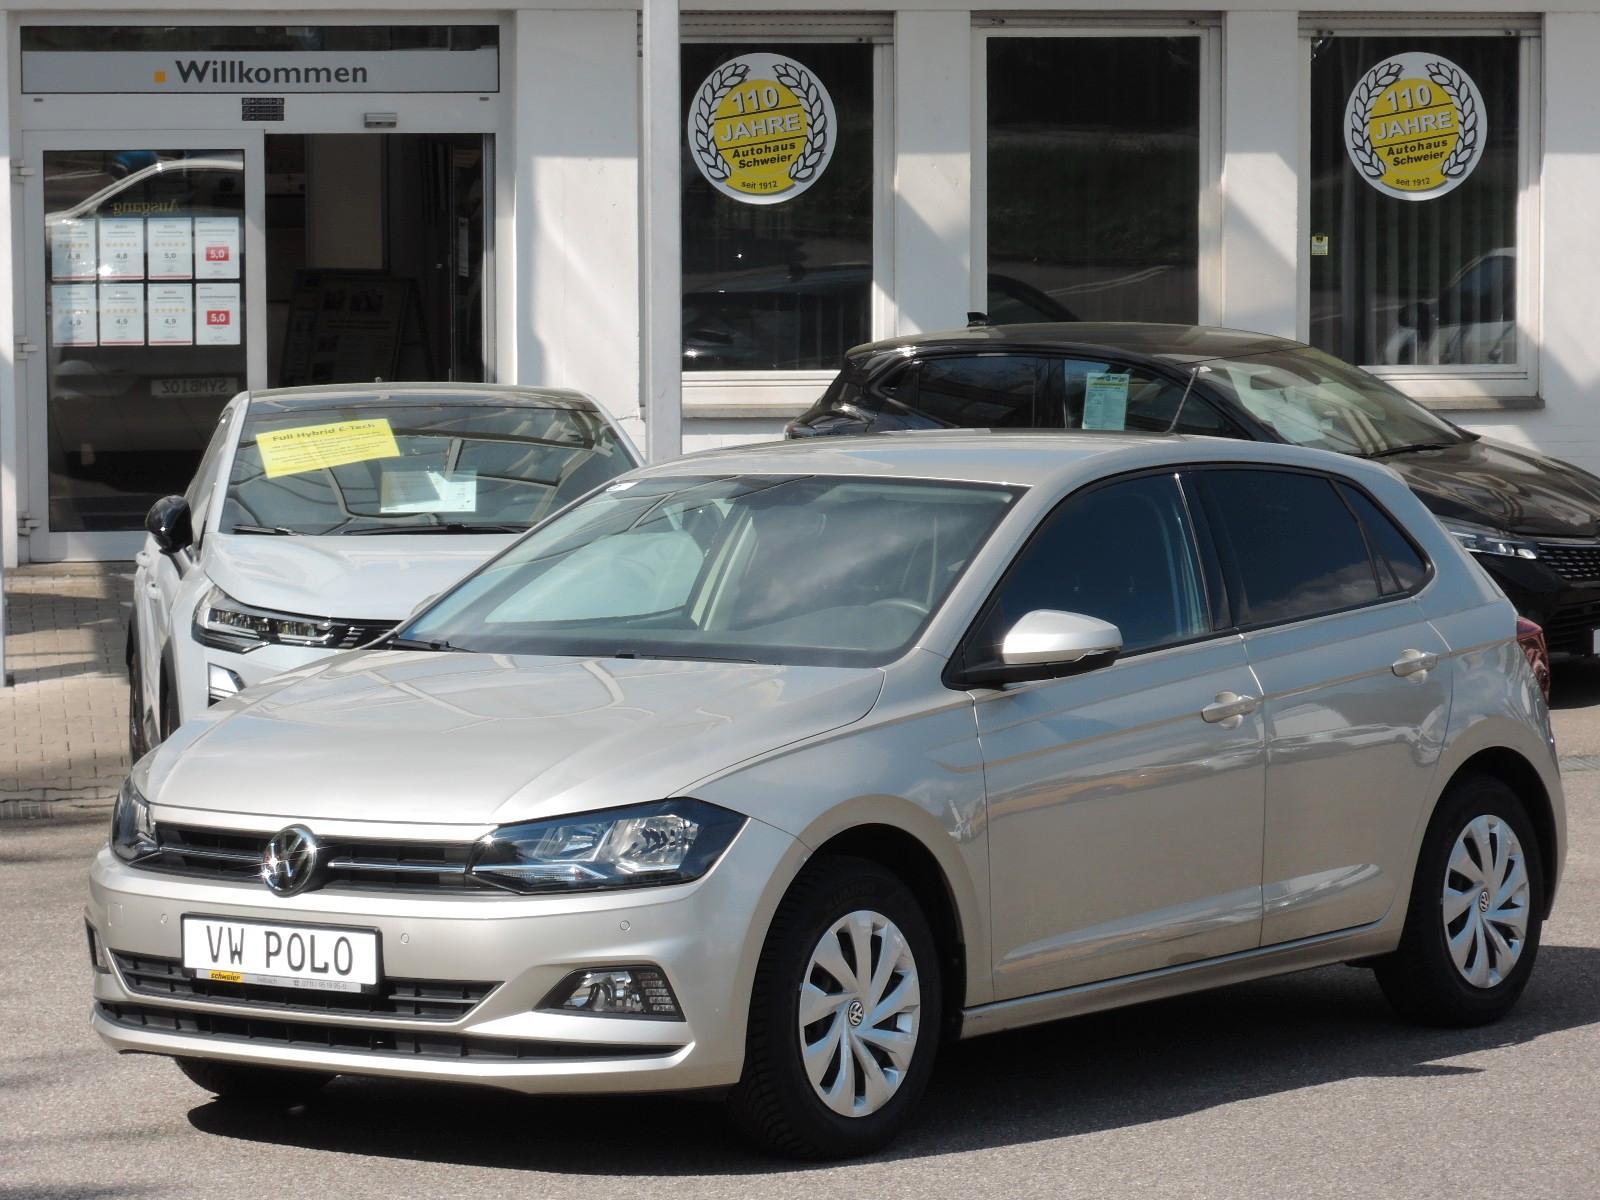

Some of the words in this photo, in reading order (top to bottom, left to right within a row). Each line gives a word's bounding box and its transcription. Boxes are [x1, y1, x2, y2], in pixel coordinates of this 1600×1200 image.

[175, 60, 367, 83] Willkommen
[732, 87, 779, 113] 110
[1386, 84, 1431, 111] 110
[721, 114, 801, 141] JAHRE
[1376, 111, 1454, 140] JAHRE
[732, 142, 796, 158] Autohaus
[1387, 139, 1448, 156] Autohaus
[738, 153, 792, 169] Schweier
[1393, 151, 1444, 166] Schweier
[741, 180, 756, 189] seit
[759, 180, 778, 189] 1912
[1395, 178, 1410, 186] seit
[1412, 177, 1431, 186] 1912
[272, 433, 294, 442] Full
[297, 427, 336, 439] Hybrid
[339, 423, 376, 433] E-Tech
[206, 925, 244, 965] VW
[264, 930, 353, 976] POLO
[210, 972, 241, 981] schweier
